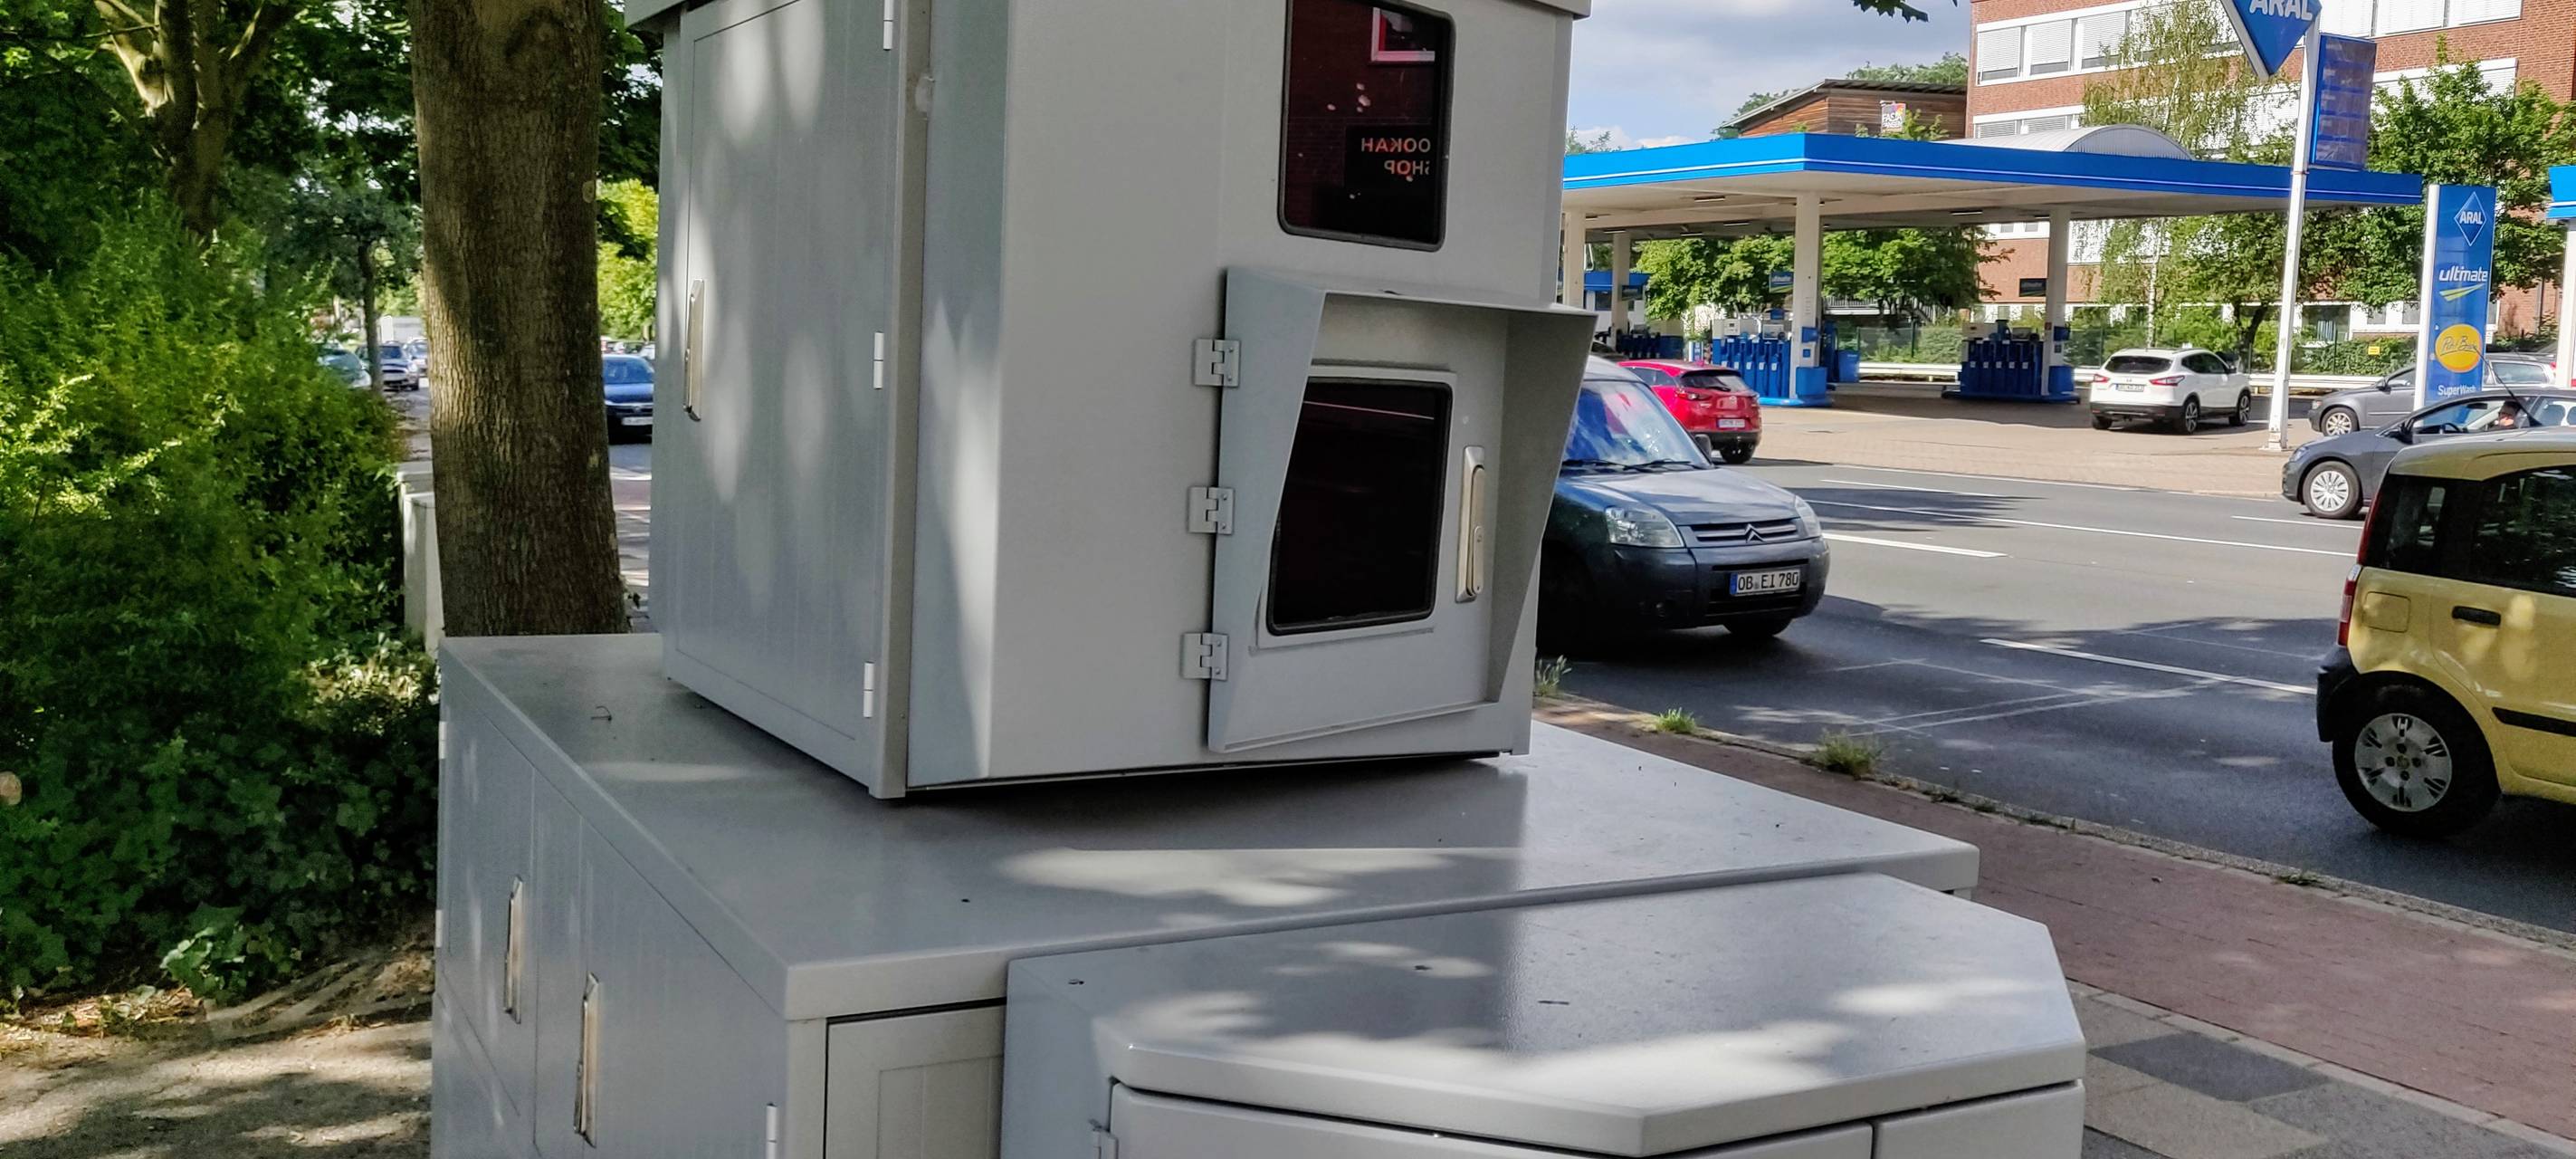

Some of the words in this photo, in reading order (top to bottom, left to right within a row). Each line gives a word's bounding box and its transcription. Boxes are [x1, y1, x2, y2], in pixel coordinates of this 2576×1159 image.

[2459, 211, 2483, 225] ARAL
[2438, 265, 2488, 282] ultimate
[2438, 384, 2476, 398] SuperWash
[1738, 576, 1753, 590] OB
[1779, 571, 1798, 588] 780
